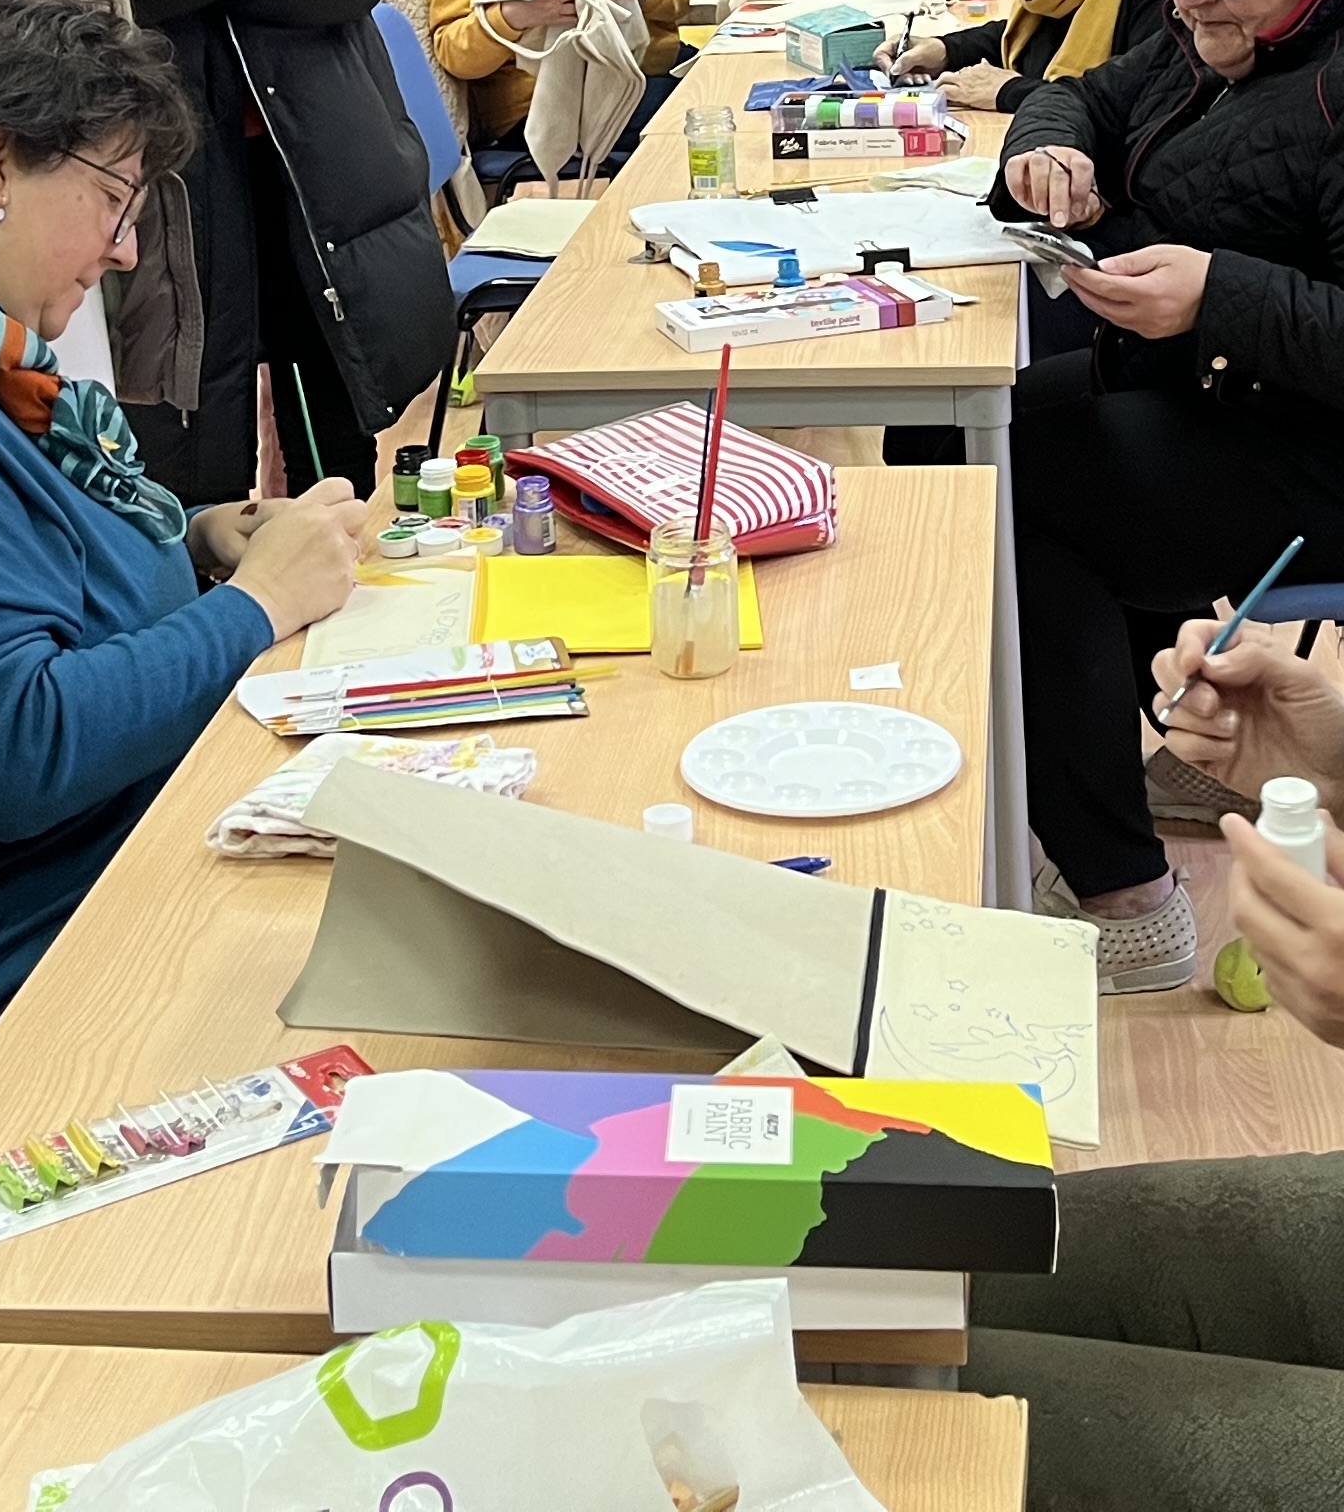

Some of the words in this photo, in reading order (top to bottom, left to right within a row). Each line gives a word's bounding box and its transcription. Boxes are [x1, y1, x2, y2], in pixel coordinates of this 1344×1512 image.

[810, 317, 836, 328] textile
[838, 314, 861, 327] paint
[704, 1102, 729, 1145] PAINT
[729, 1098, 753, 1150] FABRIC
